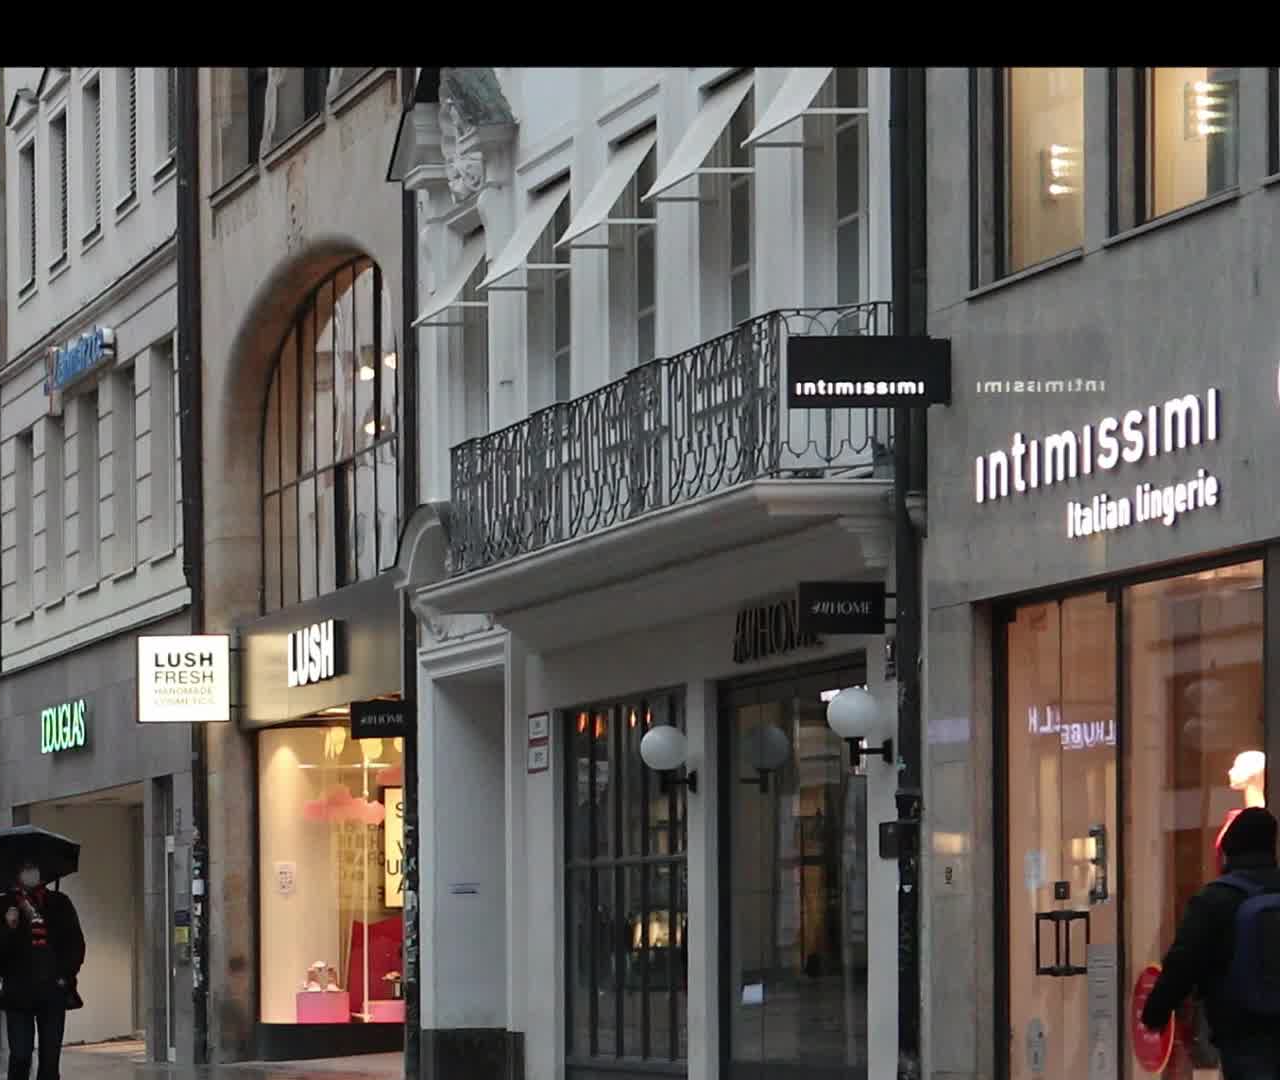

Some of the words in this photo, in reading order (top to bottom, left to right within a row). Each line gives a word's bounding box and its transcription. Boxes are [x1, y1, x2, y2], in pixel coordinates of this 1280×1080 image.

[795, 379, 925, 396] intimissimi
[976, 387, 1217, 504] intimissimi
[1066, 493, 1132, 539] Italian
[1135, 468, 1219, 527] lingerie
[154, 652, 214, 668] LUSH
[154, 670, 215, 685] FRESH
[287, 618, 336, 688] LUSH
[40, 699, 86, 754] DOUGLAS
